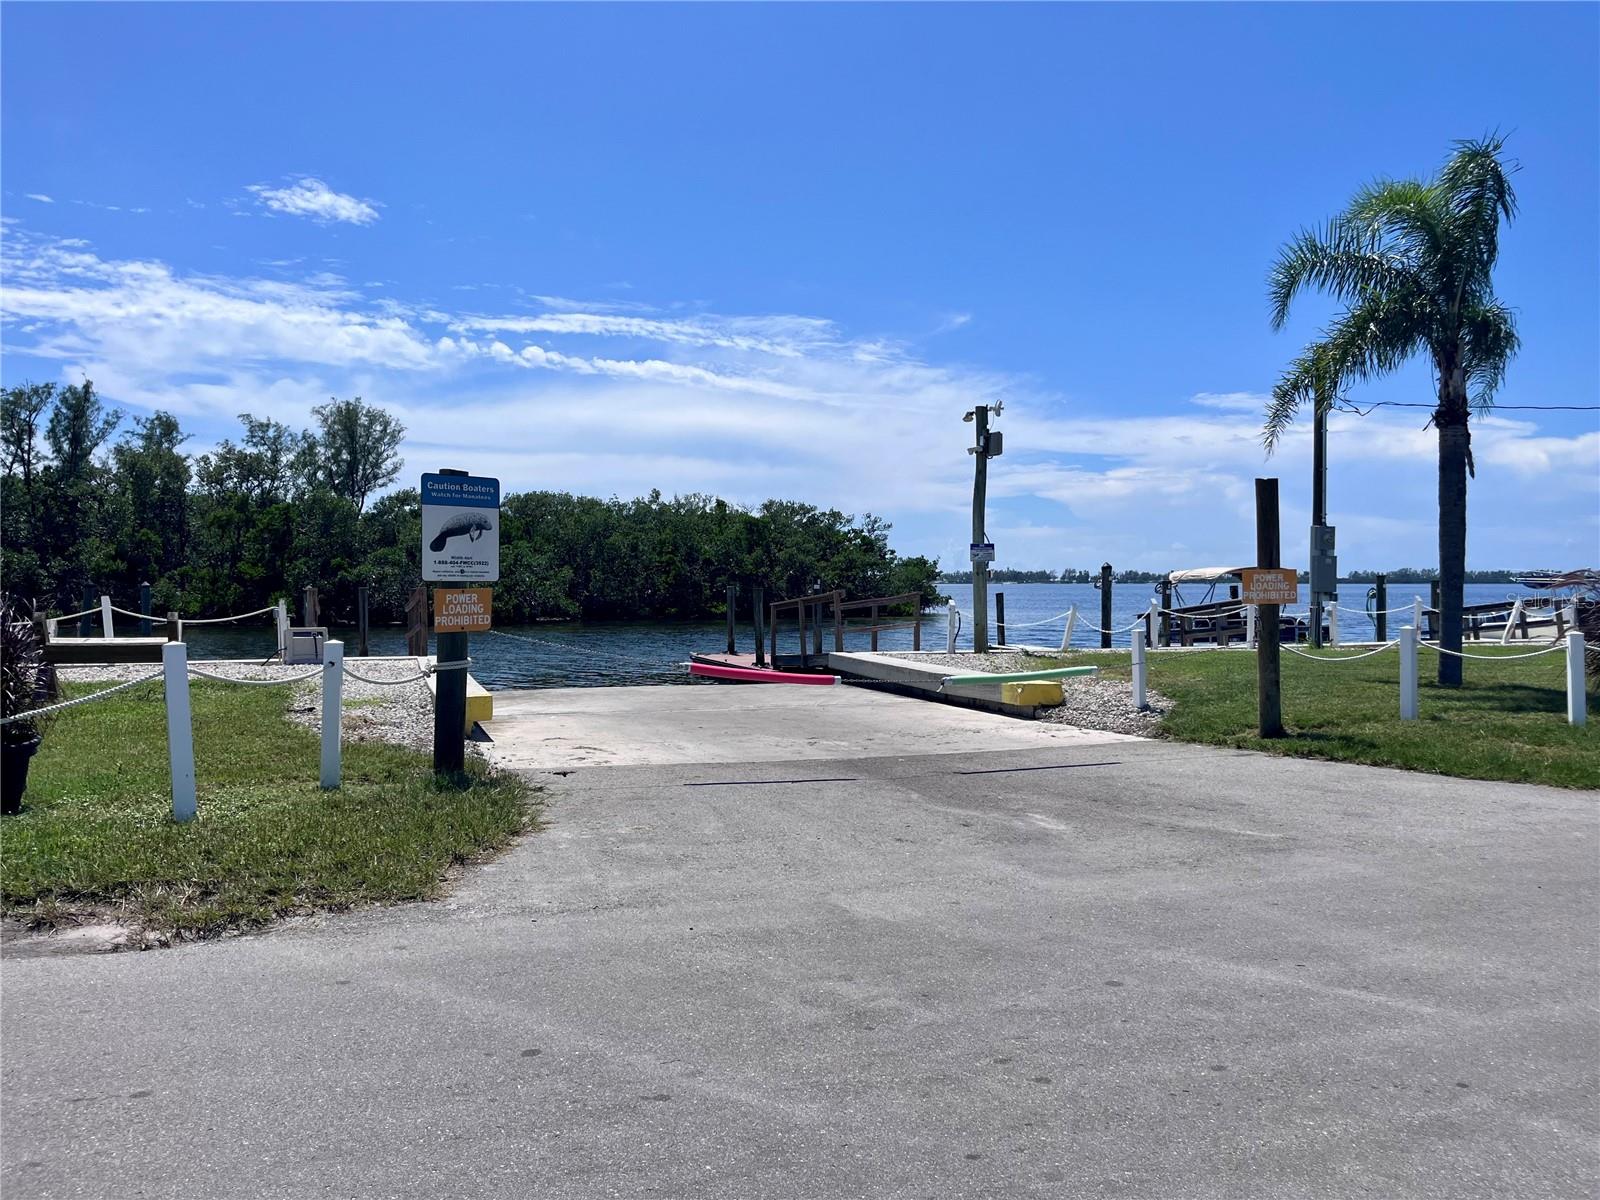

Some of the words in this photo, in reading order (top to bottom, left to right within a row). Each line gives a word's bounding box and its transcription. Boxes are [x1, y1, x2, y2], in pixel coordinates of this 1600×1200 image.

[427, 481, 461, 491] Caution
[462, 483, 495, 493] Boaters
[1253, 574, 1284, 582] POWER
[1250, 582, 1290, 590] LOADING
[446, 594, 478, 603] POWER
[1243, 591, 1297, 600] PROHIBITED
[442, 604, 484, 614] LOADING
[434, 615, 491, 626] PROHIBITED
